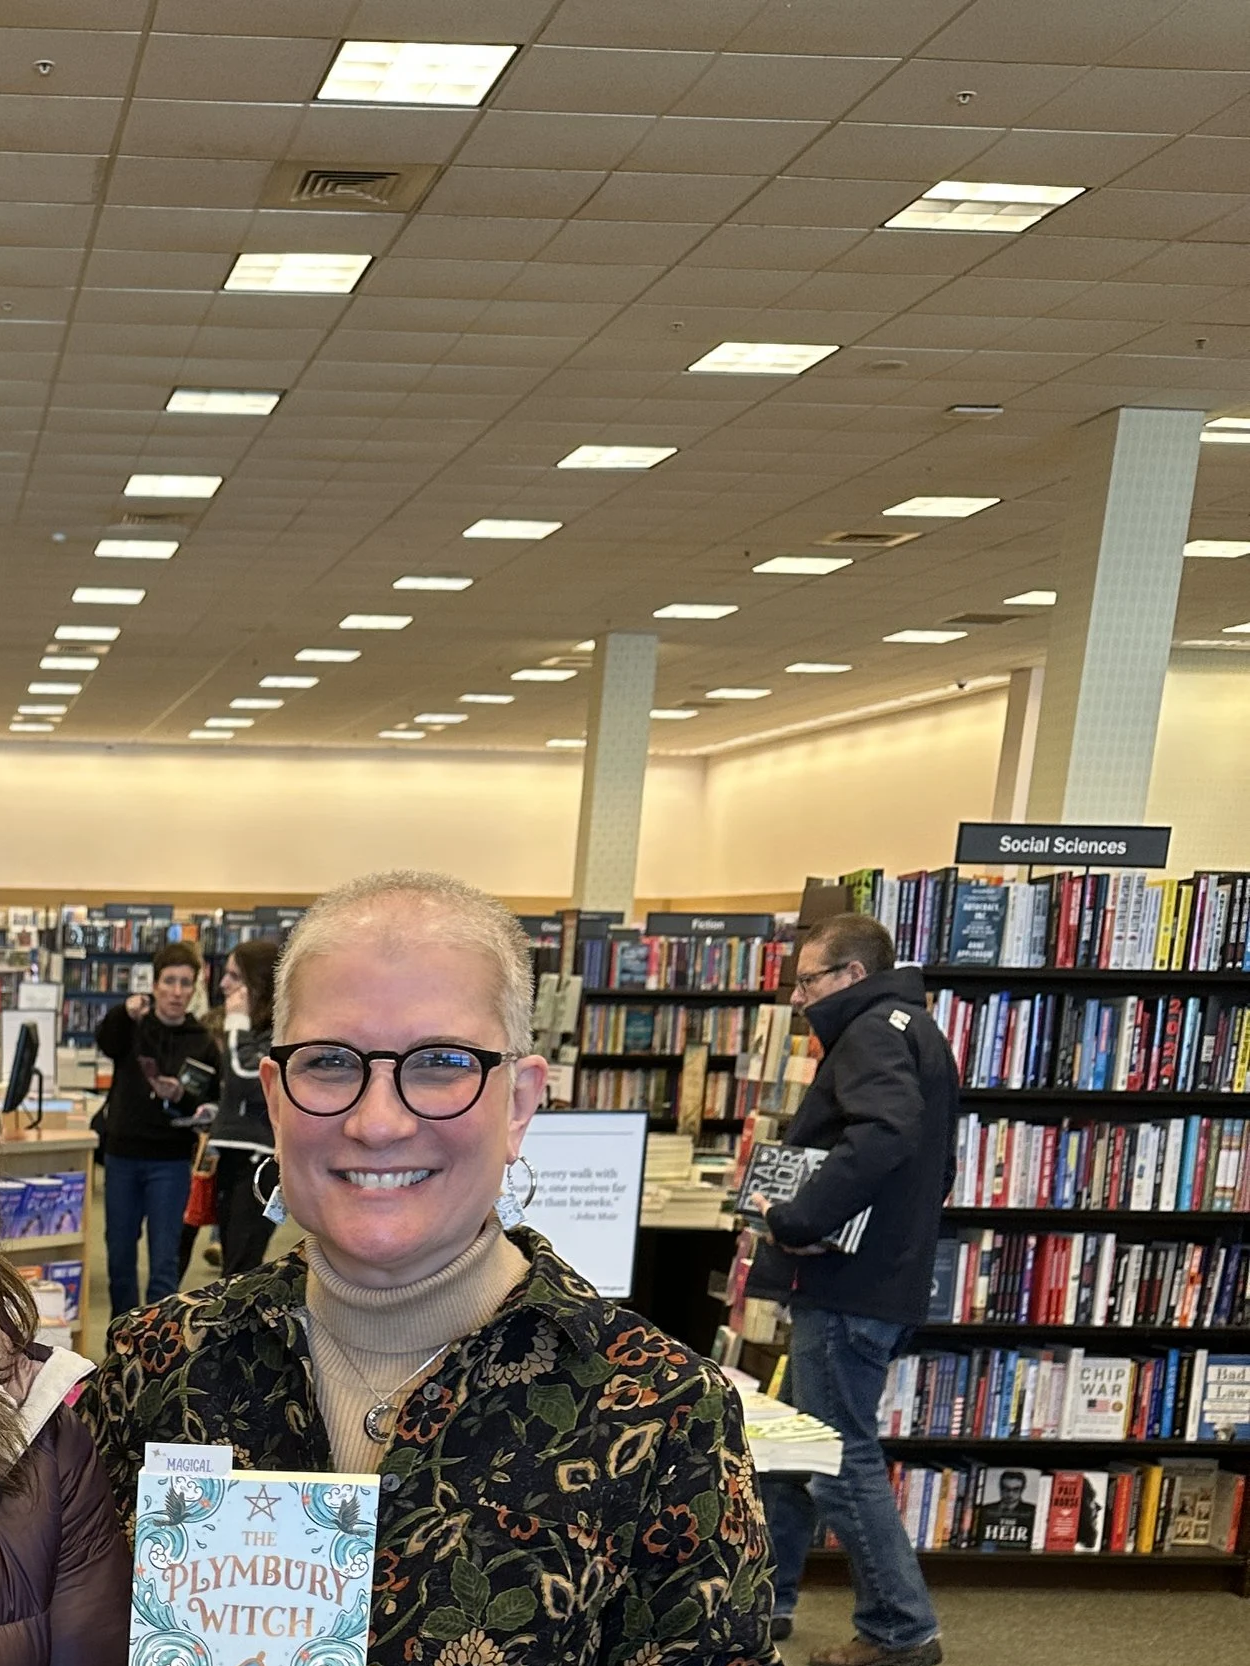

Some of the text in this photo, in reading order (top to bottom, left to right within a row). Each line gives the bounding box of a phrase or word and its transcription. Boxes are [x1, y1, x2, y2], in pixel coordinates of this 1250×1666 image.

[1000, 836, 1127, 855] Social Sciences
[692, 918, 725, 930] Fiction
[570, 1168, 592, 1179] walk
[596, 1168, 618, 1179] with
[769, 1150, 800, 1202] HOR
[1080, 1367, 1126, 1382] CHIP
[1217, 1368, 1246, 1380] Bad
[1080, 1383, 1122, 1397] WAR
[1217, 1385, 1248, 1398] Law
[166, 1456, 213, 1473] MAGICAL
[242, 1531, 277, 1547] THE
[984, 1524, 1028, 1541] HEIR
[162, 1555, 351, 1607] PLYMBURY
[187, 1597, 315, 1638] WITCH
